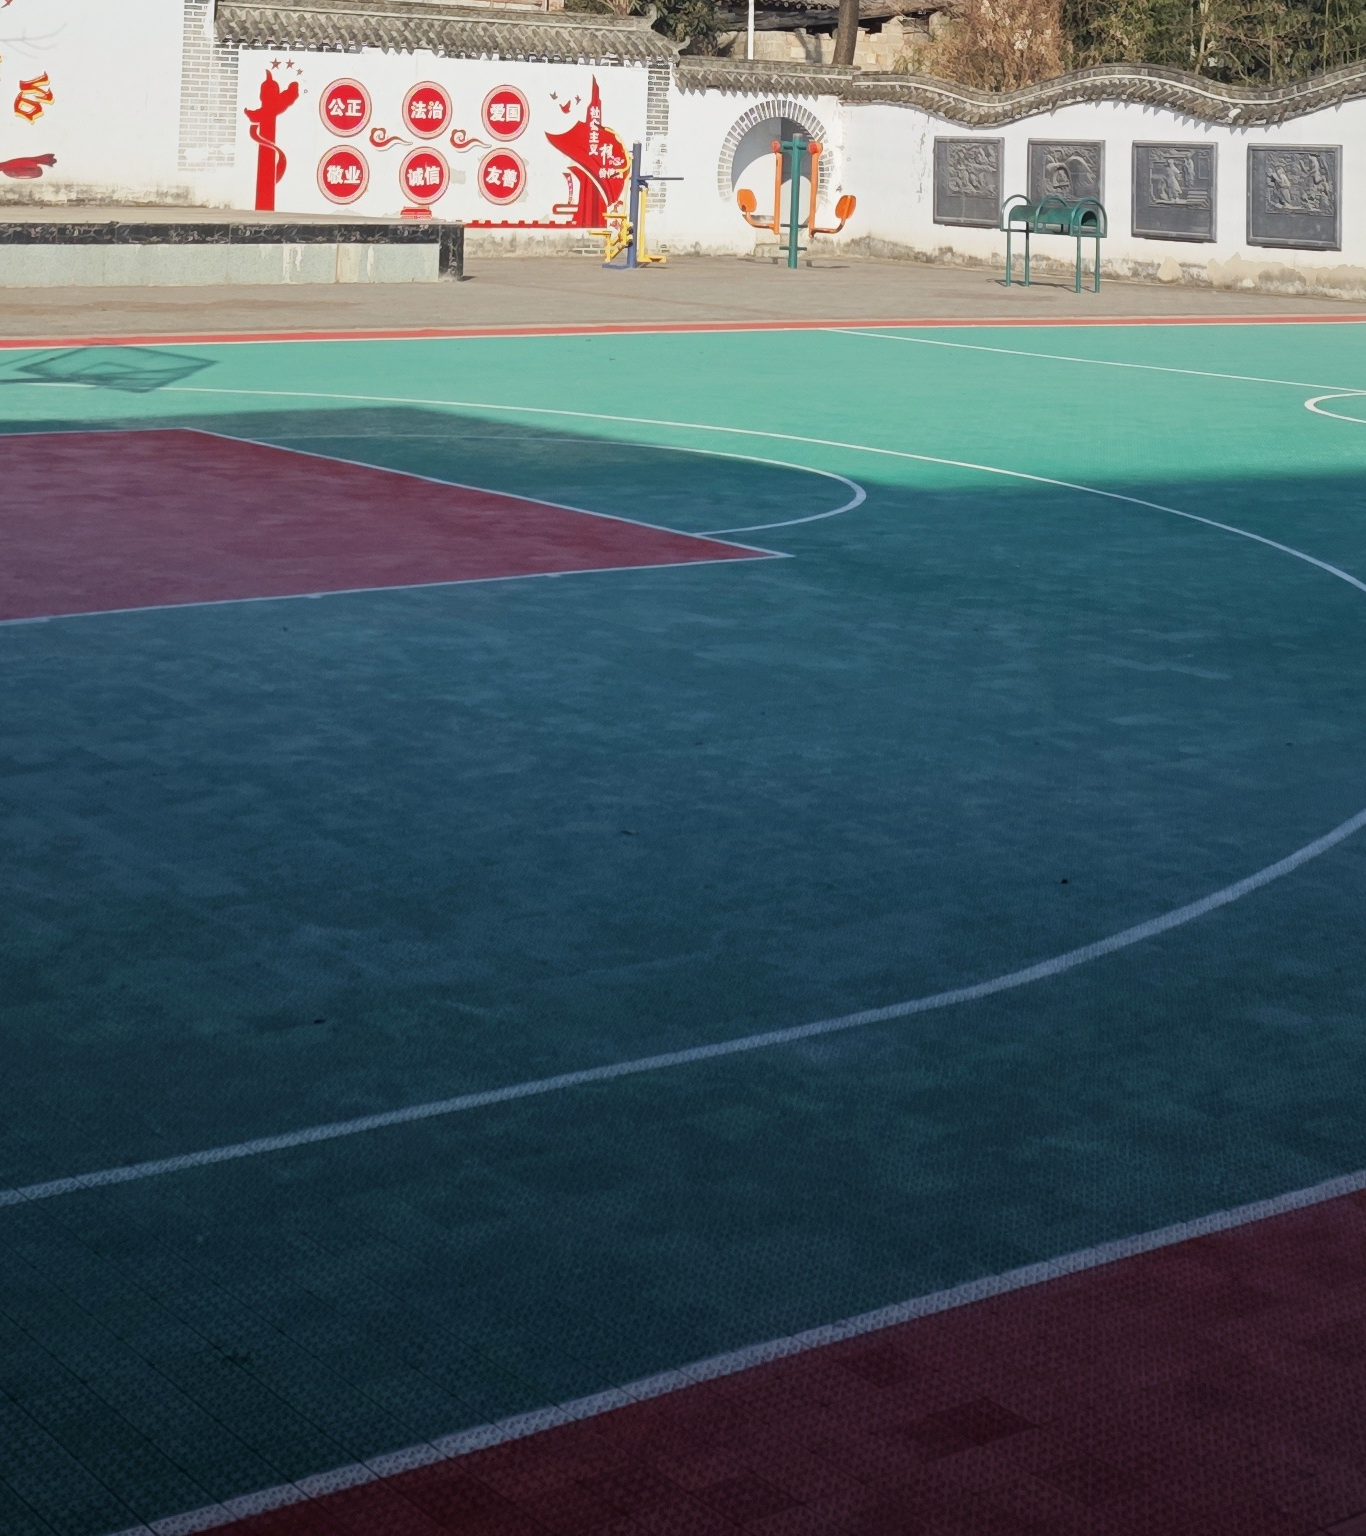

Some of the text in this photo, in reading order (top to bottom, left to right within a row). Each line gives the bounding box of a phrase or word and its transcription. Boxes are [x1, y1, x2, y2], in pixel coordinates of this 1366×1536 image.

[328, 98, 363, 117] 公正
[410, 100, 444, 120] 法治
[489, 103, 521, 123] 爱国
[588, 106, 600, 156] 社会主义
[326, 165, 362, 185] 敬业
[407, 165, 441, 187] 诚信
[486, 166, 517, 189] 友善
